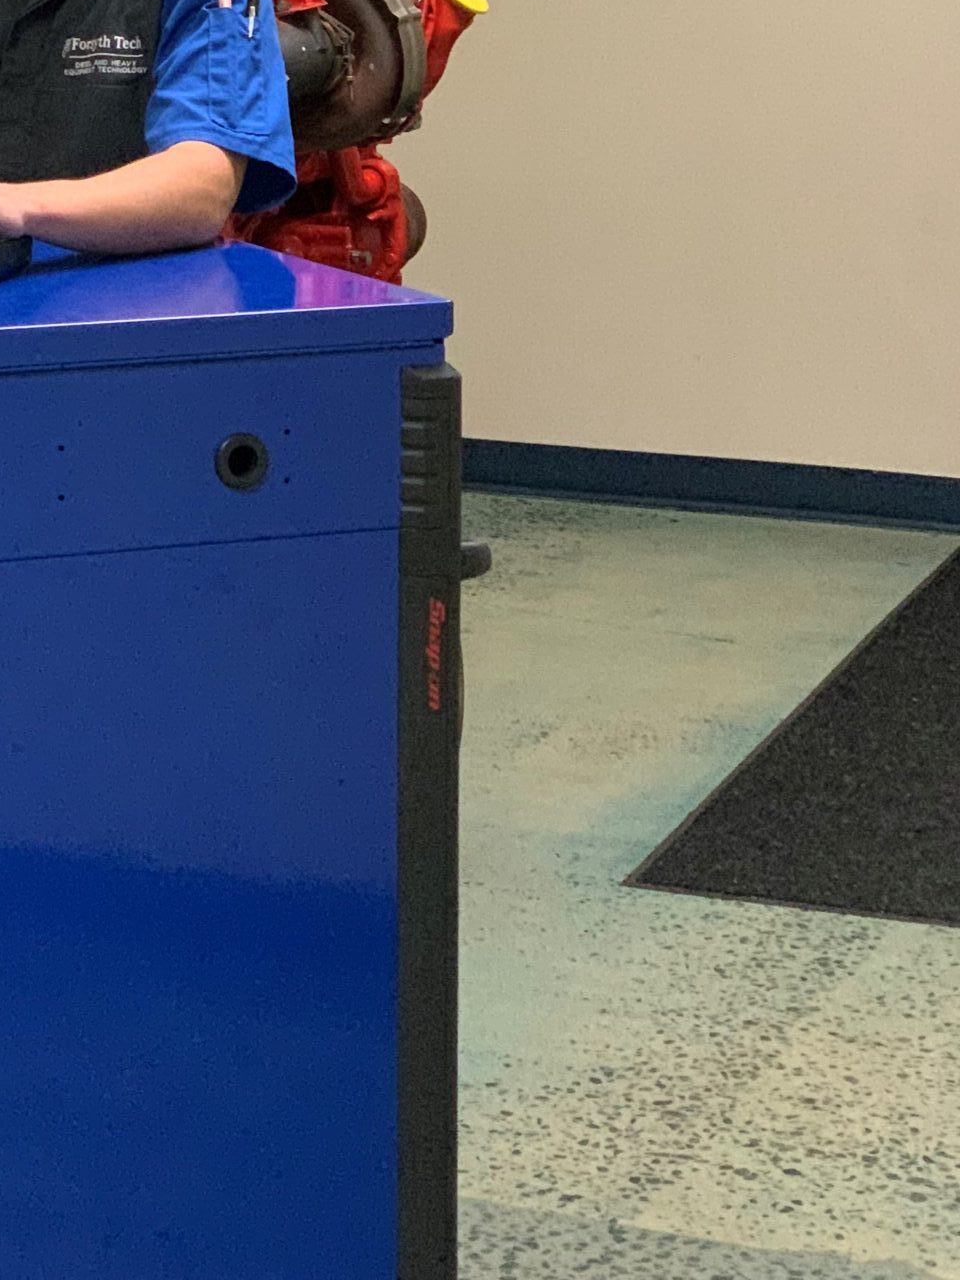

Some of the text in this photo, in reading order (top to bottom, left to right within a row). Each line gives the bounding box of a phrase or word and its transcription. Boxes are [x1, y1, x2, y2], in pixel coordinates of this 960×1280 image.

[114, 36, 142, 49] Tech
[111, 59, 137, 67] HEAVY
[98, 66, 147, 74] TECHNOLOGY
